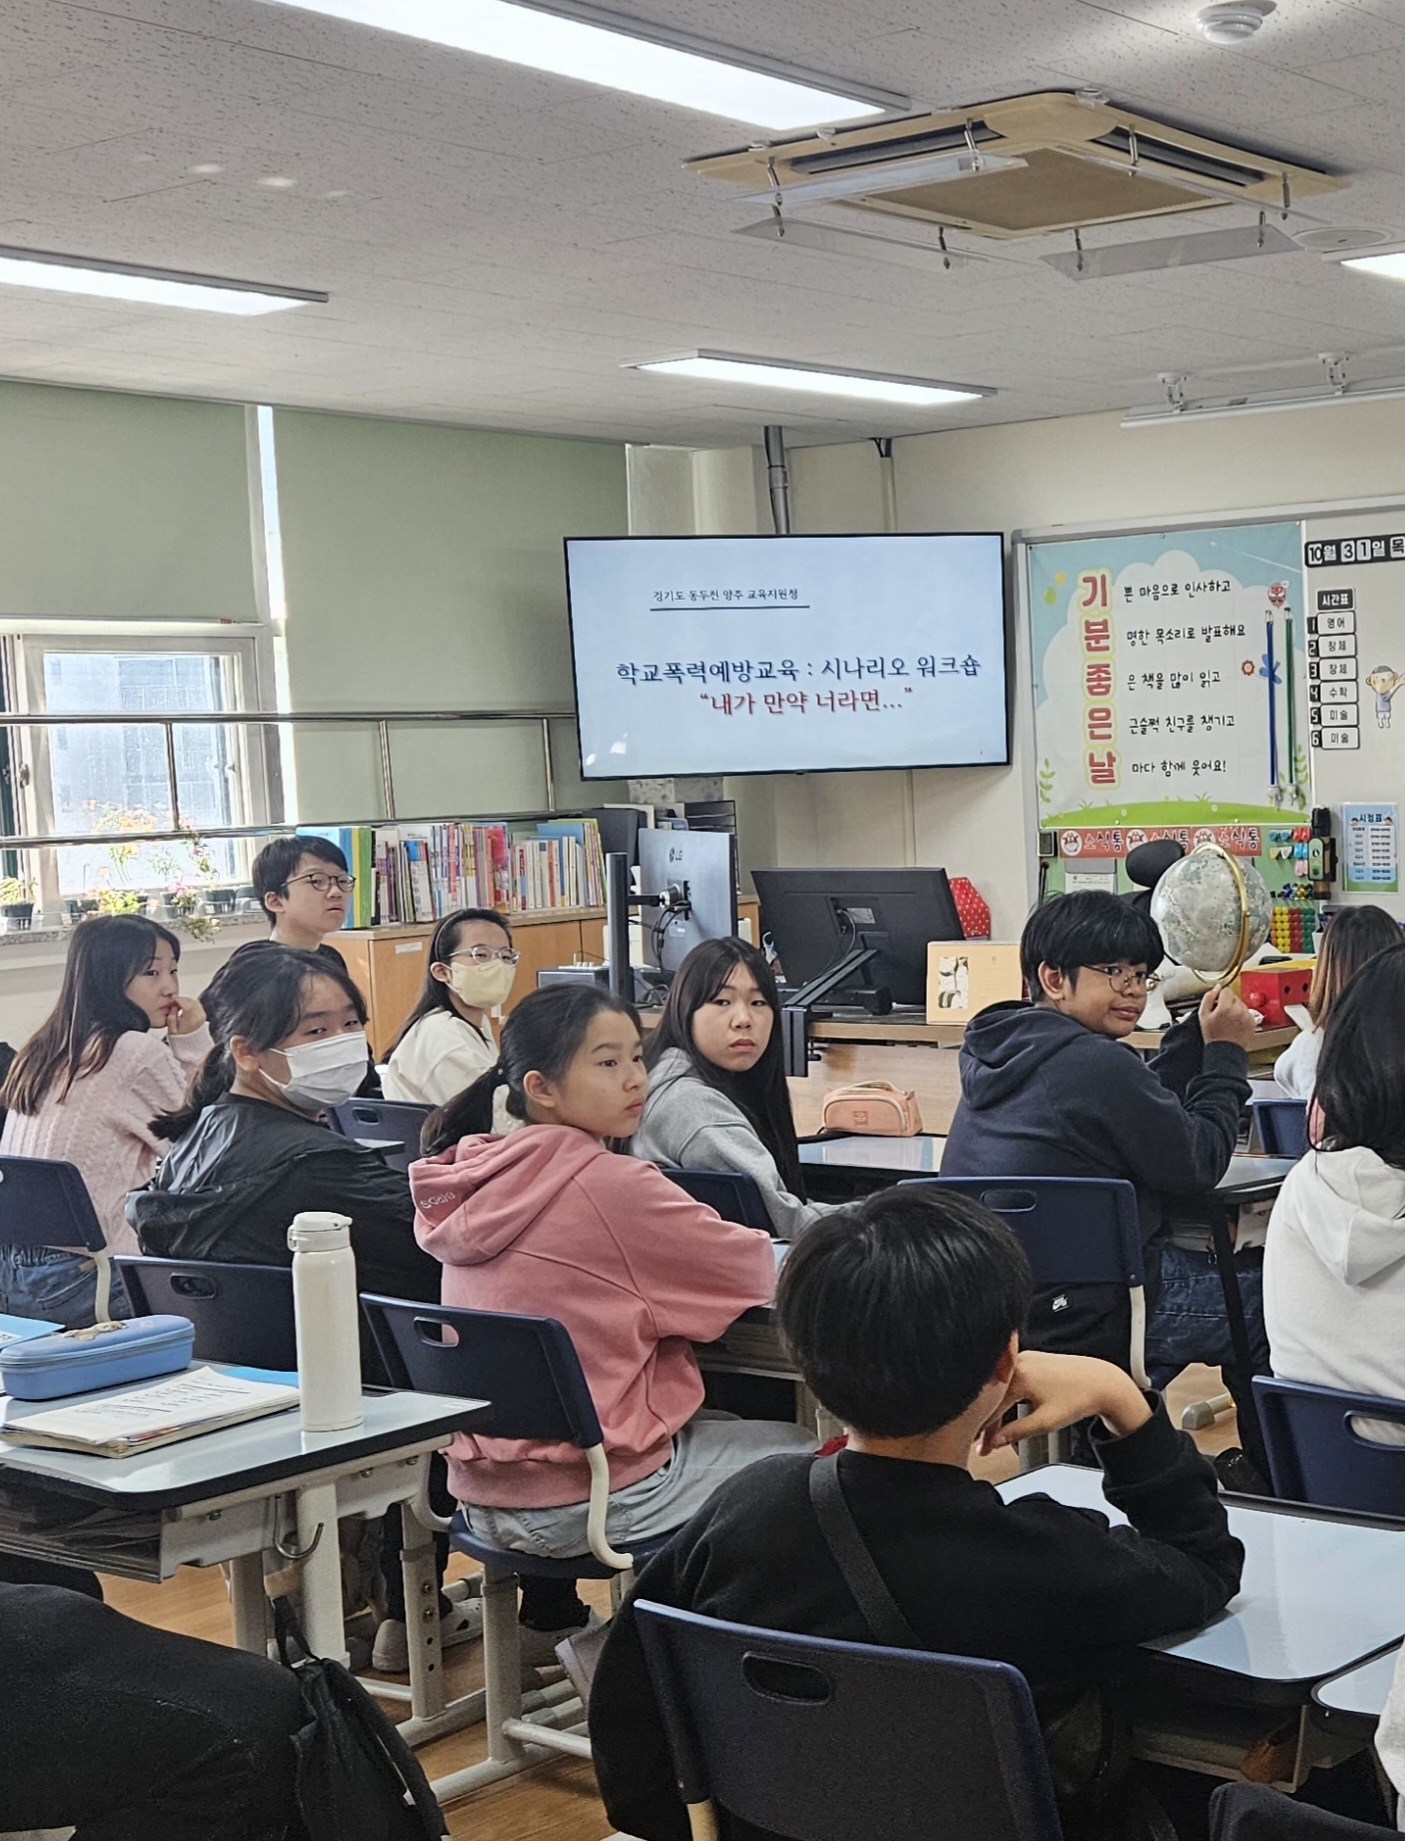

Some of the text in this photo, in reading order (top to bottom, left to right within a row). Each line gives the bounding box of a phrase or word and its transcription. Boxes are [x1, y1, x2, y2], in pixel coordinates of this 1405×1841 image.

[1308, 543, 1337, 565] 10월
[1341, 539, 1386, 562] 31일
[653, 588, 799, 602] 경기도 동두천 양주 교육지원청
[1124, 580, 1231, 603] 쁜 마음으로 인사하고
[1321, 593, 1349, 606] 시간표
[1327, 617, 1345, 629] 영어
[1127, 624, 1246, 647] 명한 목소리로 발표해요
[1309, 641, 1317, 656] 2
[615, 659, 800, 686] 학교폭력예방교육
[821, 656, 911, 681] 시나리오
[916, 653, 981, 679] 워크숍
[1310, 662, 1318, 678] 3
[1127, 670, 1221, 691] 은 책을 많이 읽고
[1310, 685, 1347, 701] 4 수학
[763, 691, 808, 715] 만약
[1311, 708, 1348, 722] 5 미술
[1129, 715, 1235, 735] 근슬쩍 친구를 챙기고
[1311, 731, 1349, 746] 6 미술
[1132, 760, 1226, 777] 마다 함께 웃어요!
[1084, 829, 1124, 853] 소식통
[1218, 827, 1260, 850] 소식통
